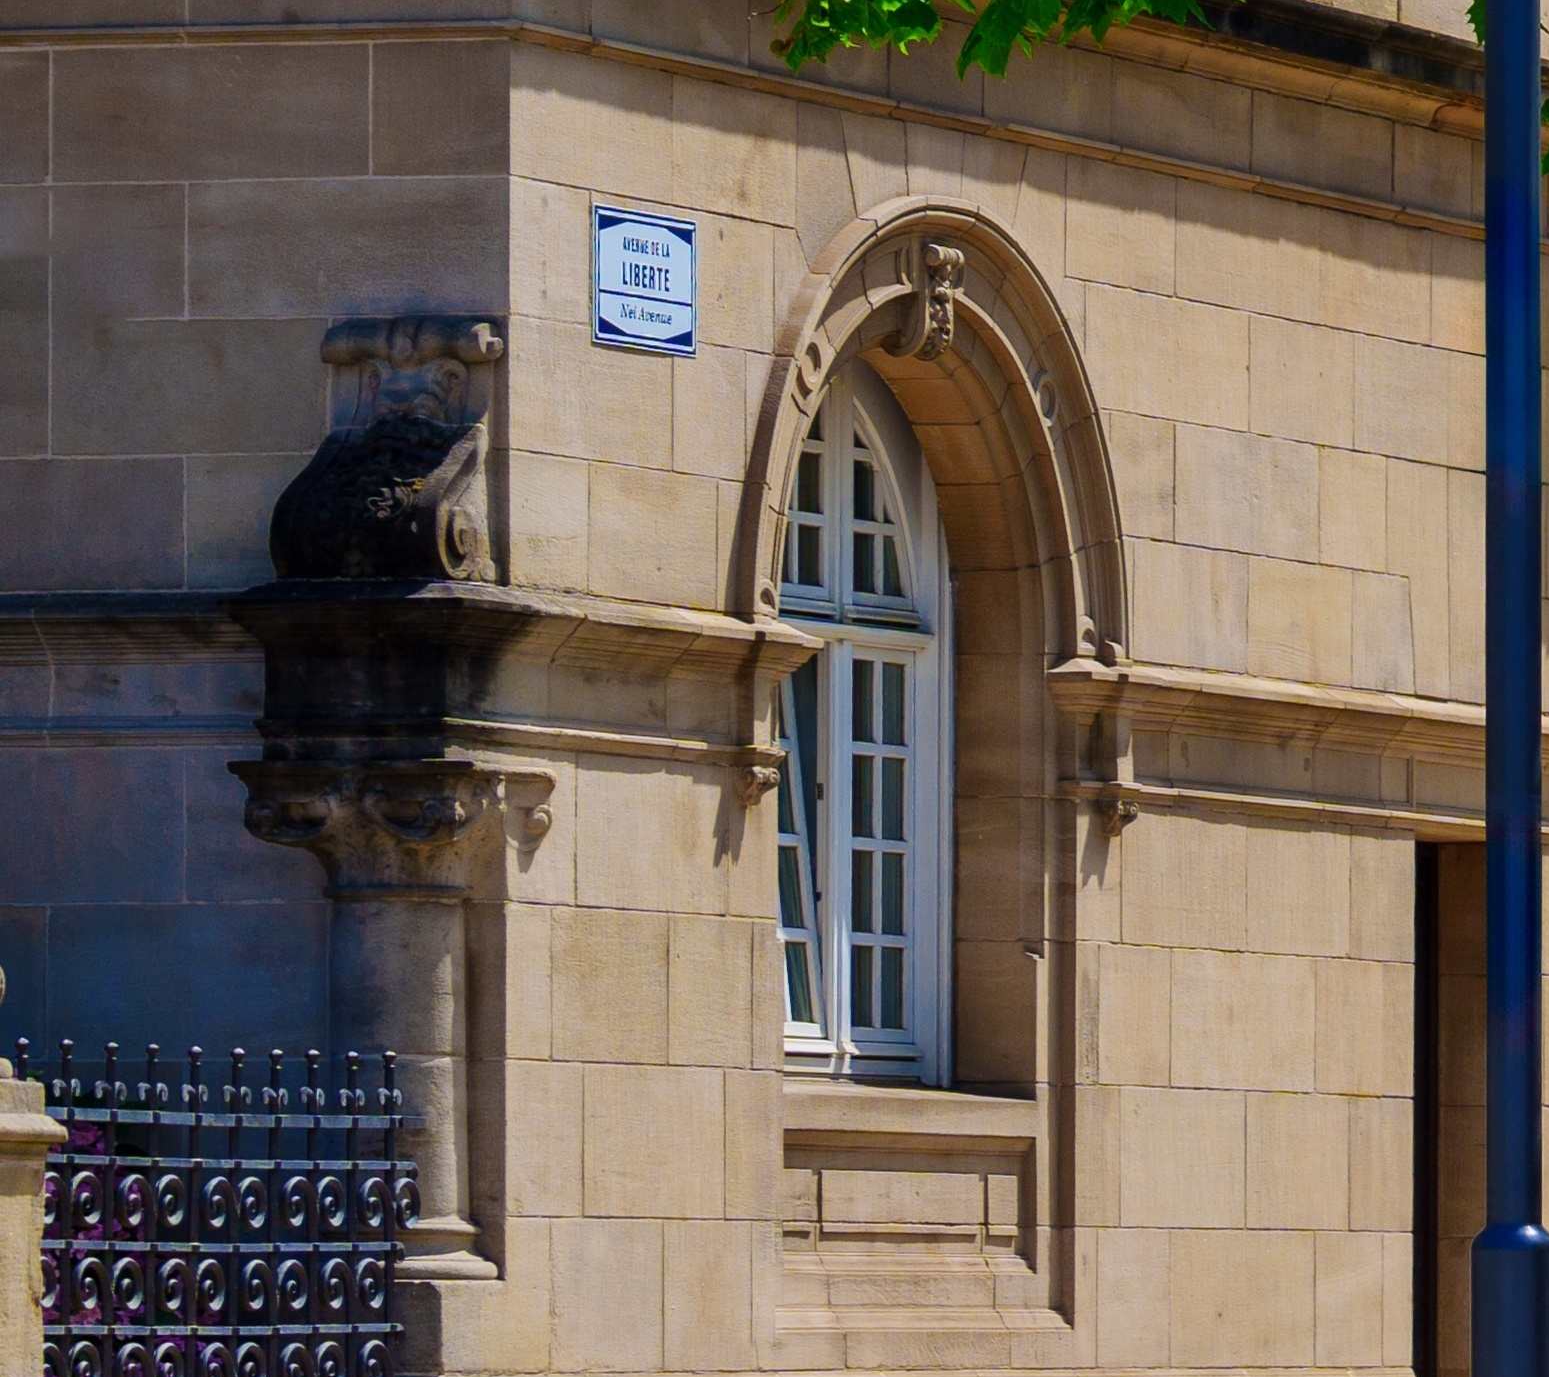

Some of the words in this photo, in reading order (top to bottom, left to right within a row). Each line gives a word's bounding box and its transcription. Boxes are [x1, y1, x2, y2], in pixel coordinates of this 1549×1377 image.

[623, 236, 649, 255] AVENUE
[651, 241, 660, 256] DE
[662, 242, 670, 258] LA
[622, 261, 670, 292] LIBERTE
[620, 303, 636, 320] Nei
[638, 307, 672, 325] Avenue
